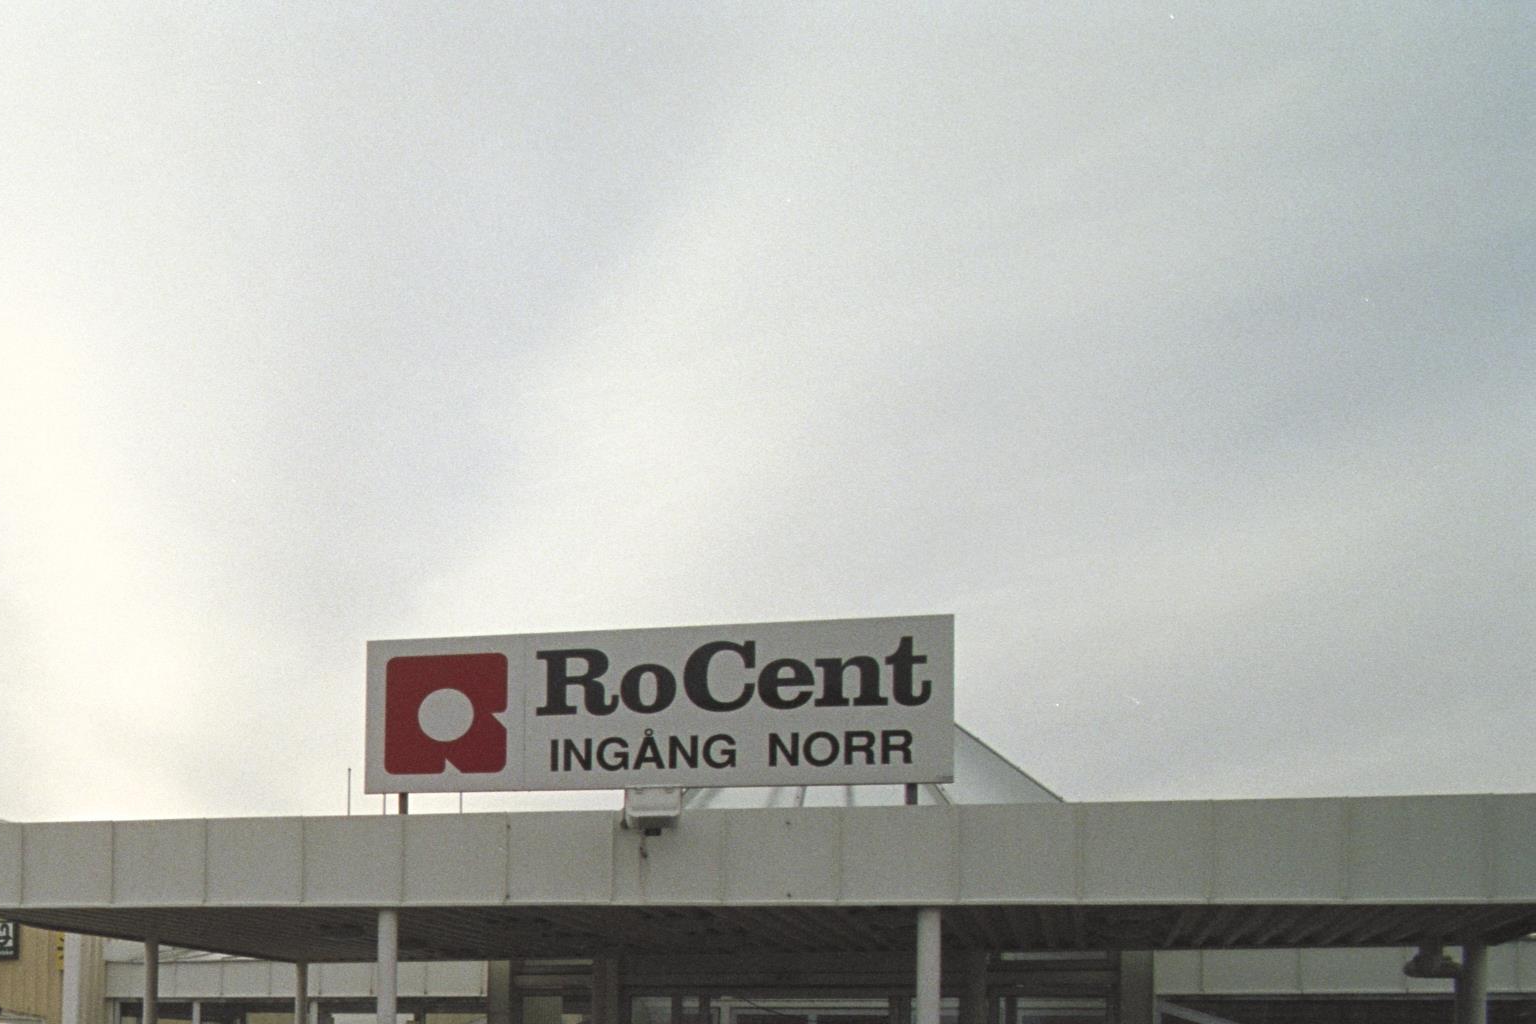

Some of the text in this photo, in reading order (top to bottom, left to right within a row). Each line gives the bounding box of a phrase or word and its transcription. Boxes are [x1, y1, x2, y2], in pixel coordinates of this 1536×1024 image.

[536, 636, 932, 717] RoCent
[550, 729, 913, 772] INGÅNG NORR
